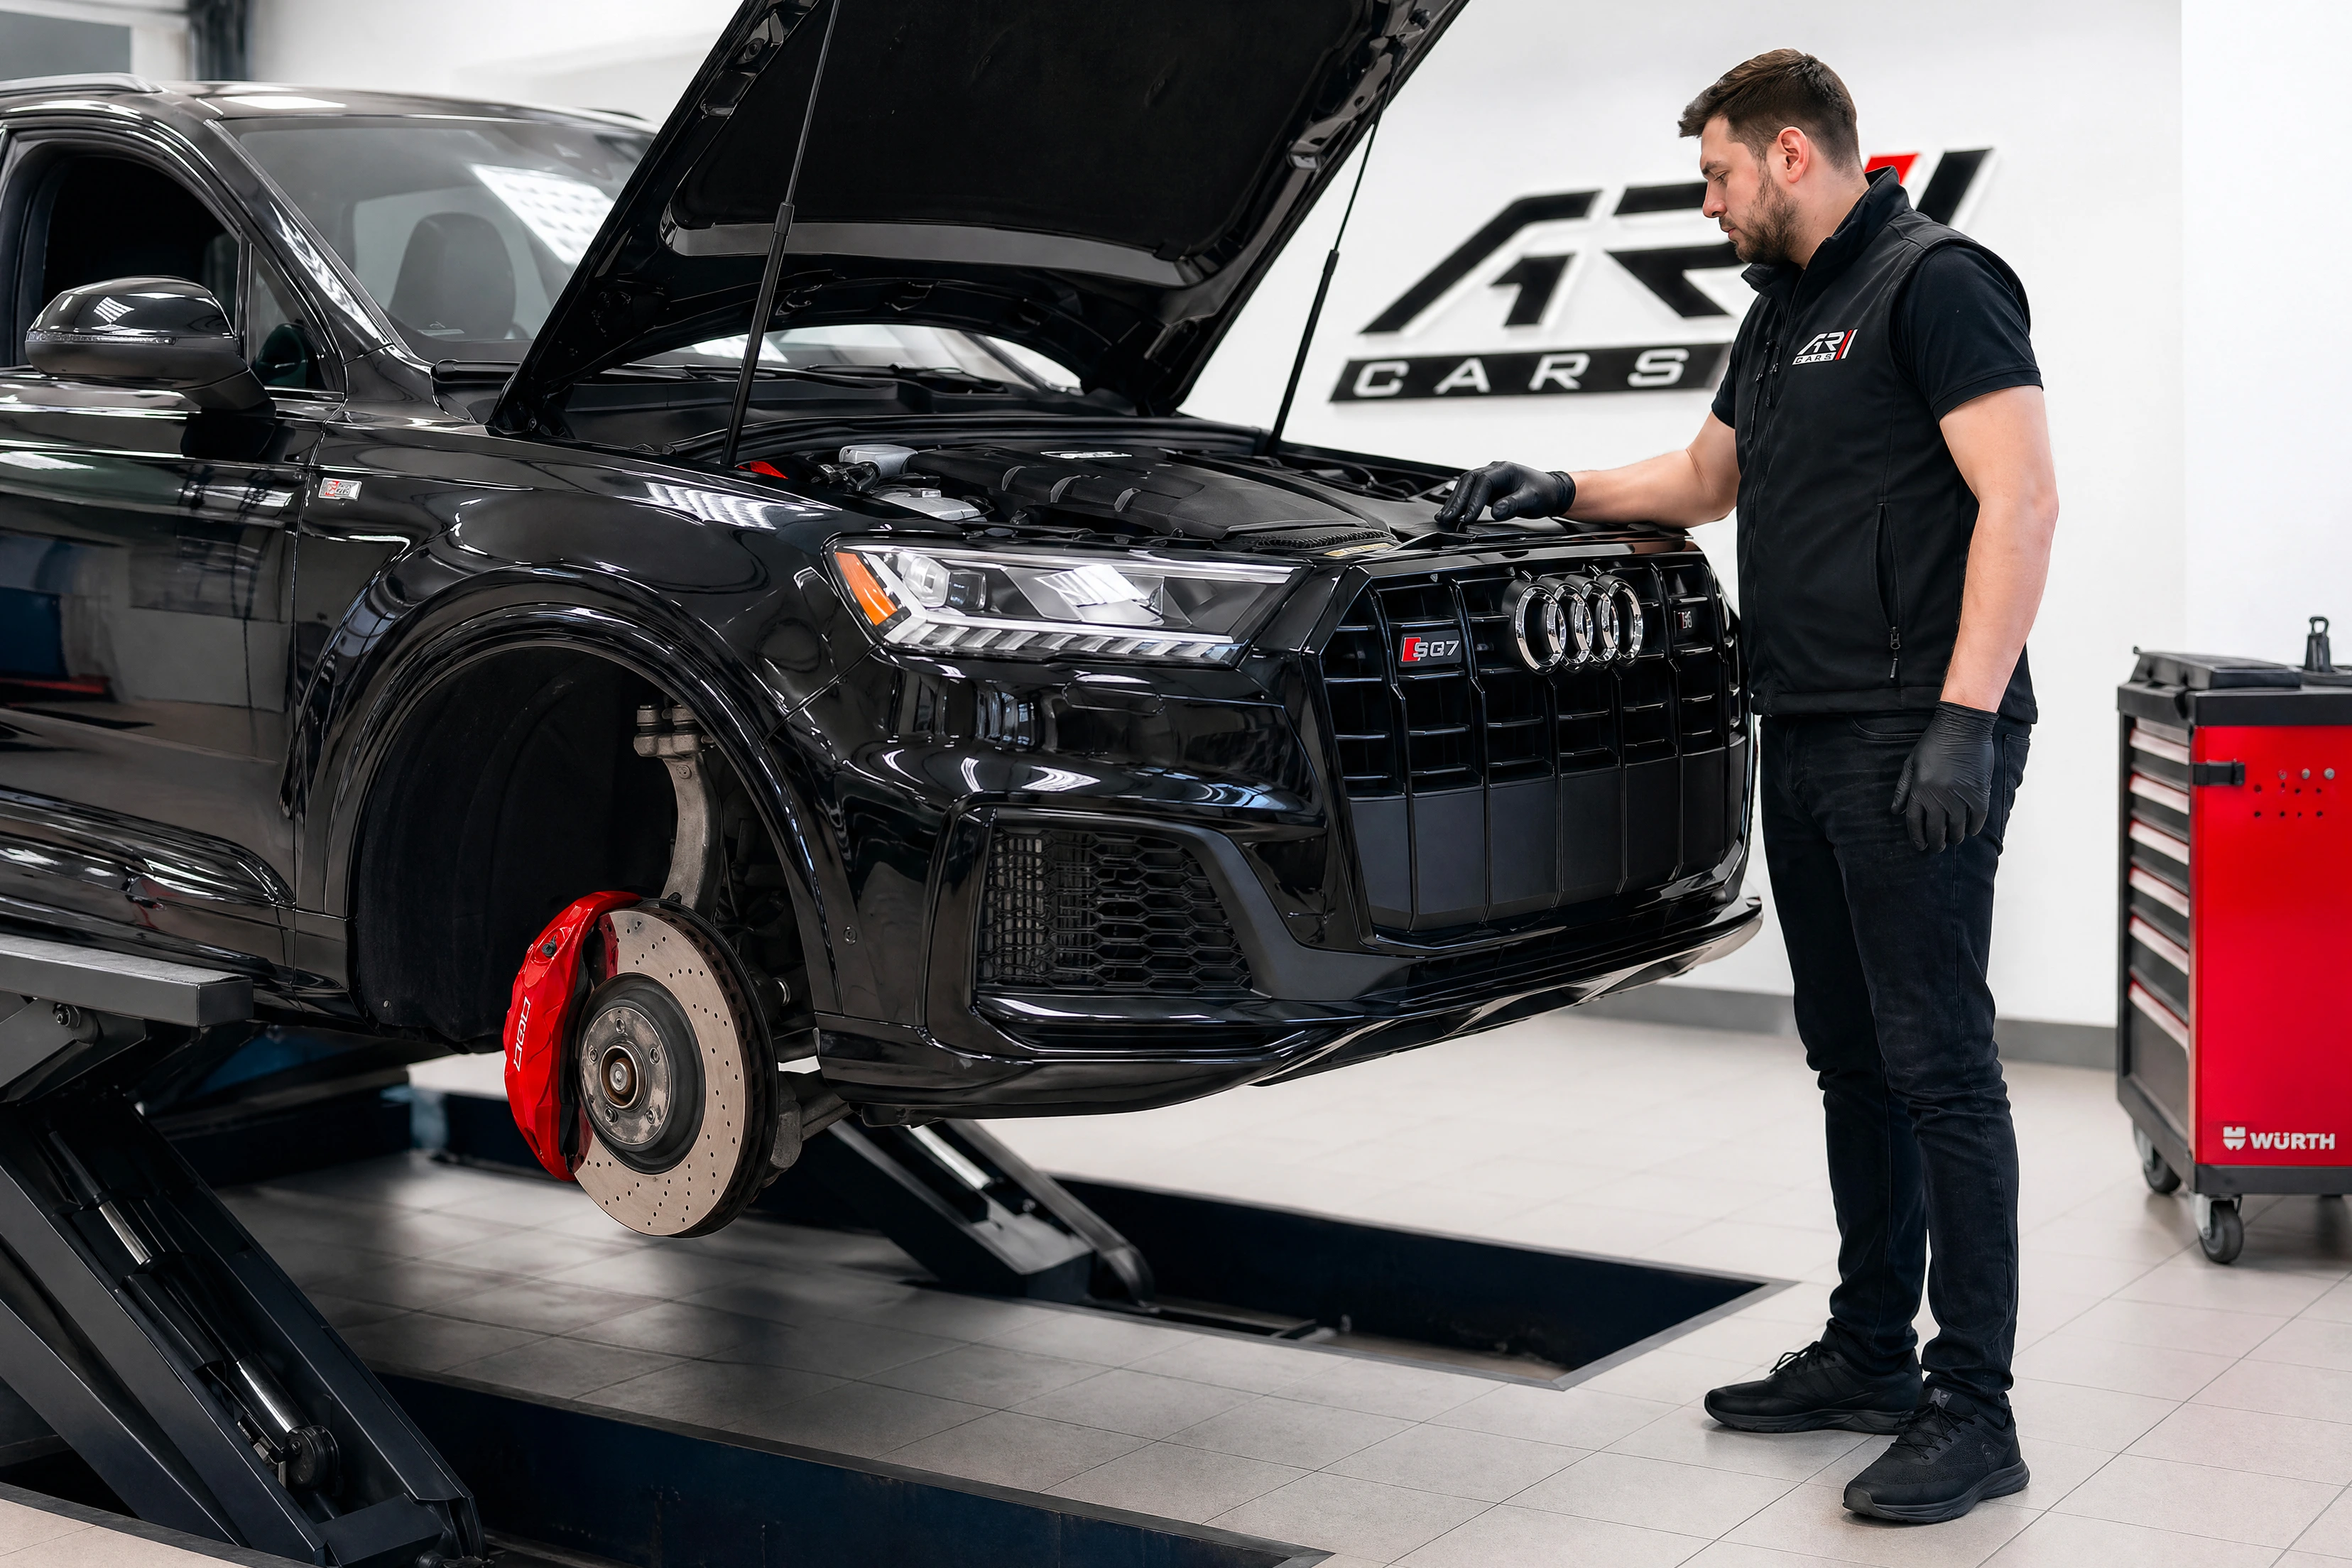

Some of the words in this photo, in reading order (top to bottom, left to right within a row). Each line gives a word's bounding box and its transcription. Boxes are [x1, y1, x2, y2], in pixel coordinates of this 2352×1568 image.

[1795, 354, 1832, 364] CARS
[1353, 348, 1690, 398] CARS
[2250, 1131, 2336, 1150] WÜRTH
